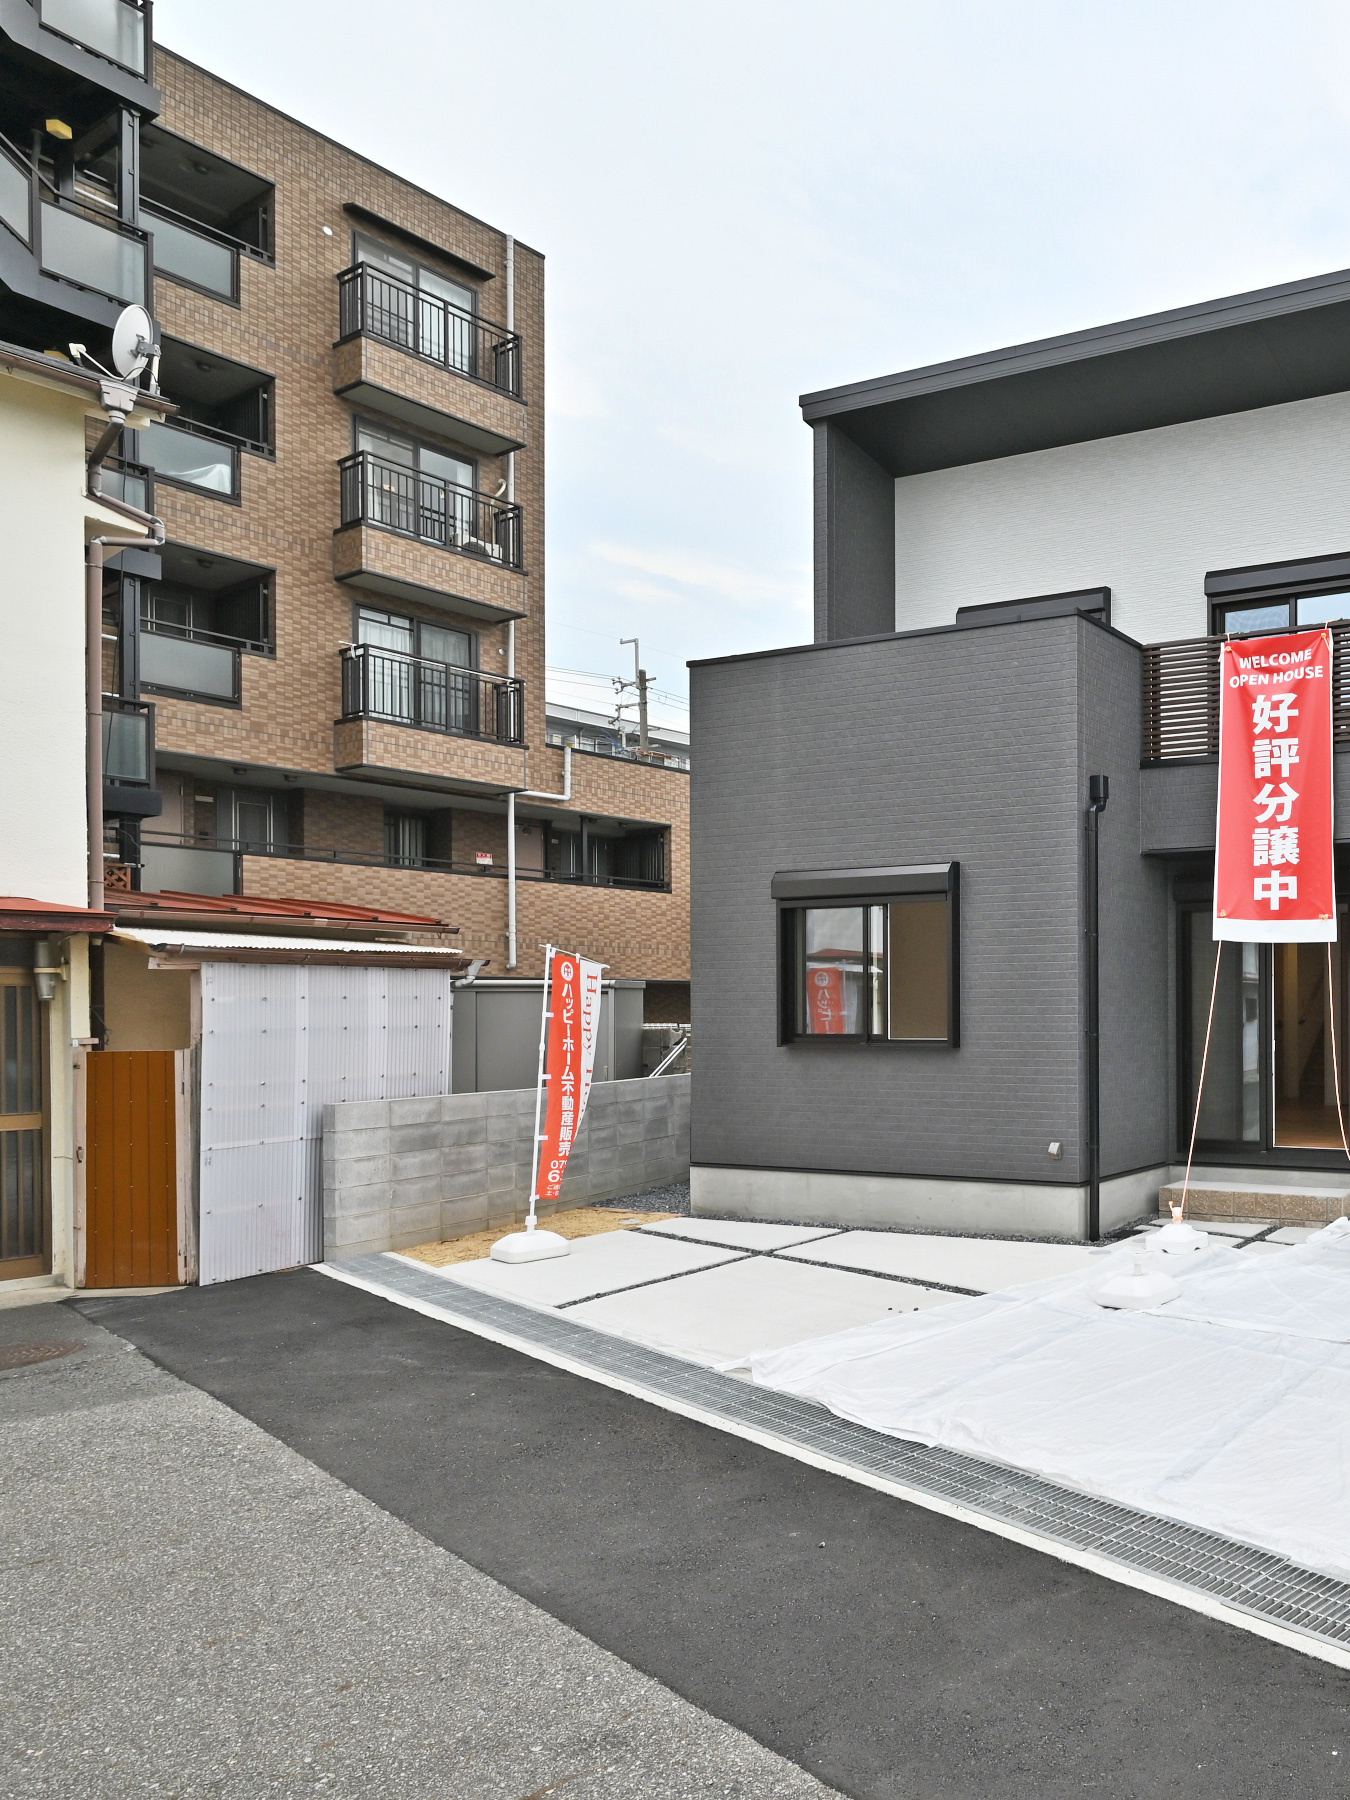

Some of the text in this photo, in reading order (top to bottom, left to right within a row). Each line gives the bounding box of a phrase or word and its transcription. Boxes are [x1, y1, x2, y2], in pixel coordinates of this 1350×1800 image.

[1229, 666, 1324, 688] OPEN HOUSE
[1239, 649, 1312, 669] WELCOME
[1252, 692, 1301, 911] 好評分譲中
[557, 983, 575, 1156] ハッピーホーム不動産販売
